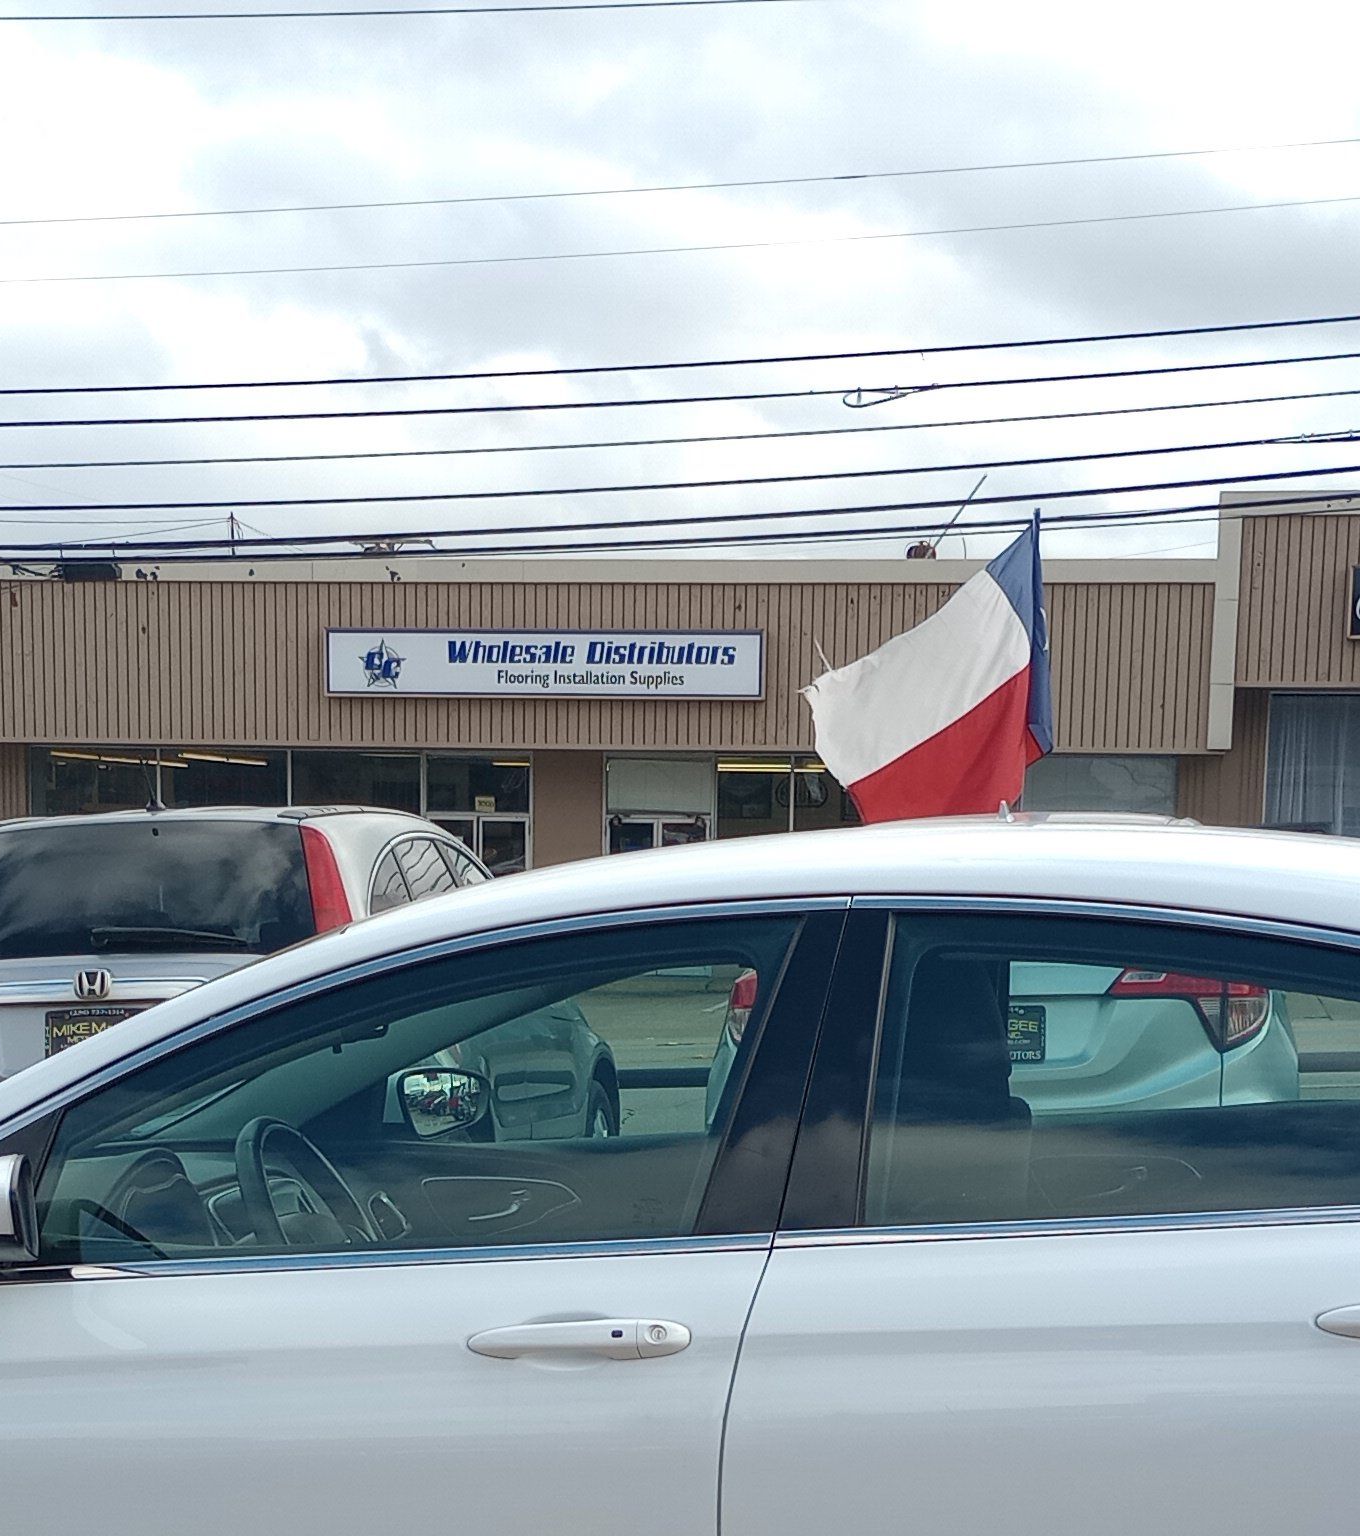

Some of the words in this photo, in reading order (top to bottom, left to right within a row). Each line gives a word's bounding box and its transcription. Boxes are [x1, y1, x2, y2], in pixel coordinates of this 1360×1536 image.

[447, 640, 575, 665] Wholesale
[586, 641, 738, 666] Distributors
[497, 669, 550, 687] Flooring
[554, 670, 626, 686] Installation
[629, 671, 685, 690] Supplies
[52, 1022, 91, 1038] MIKE
[1009, 1050, 1042, 1060] OTORS
